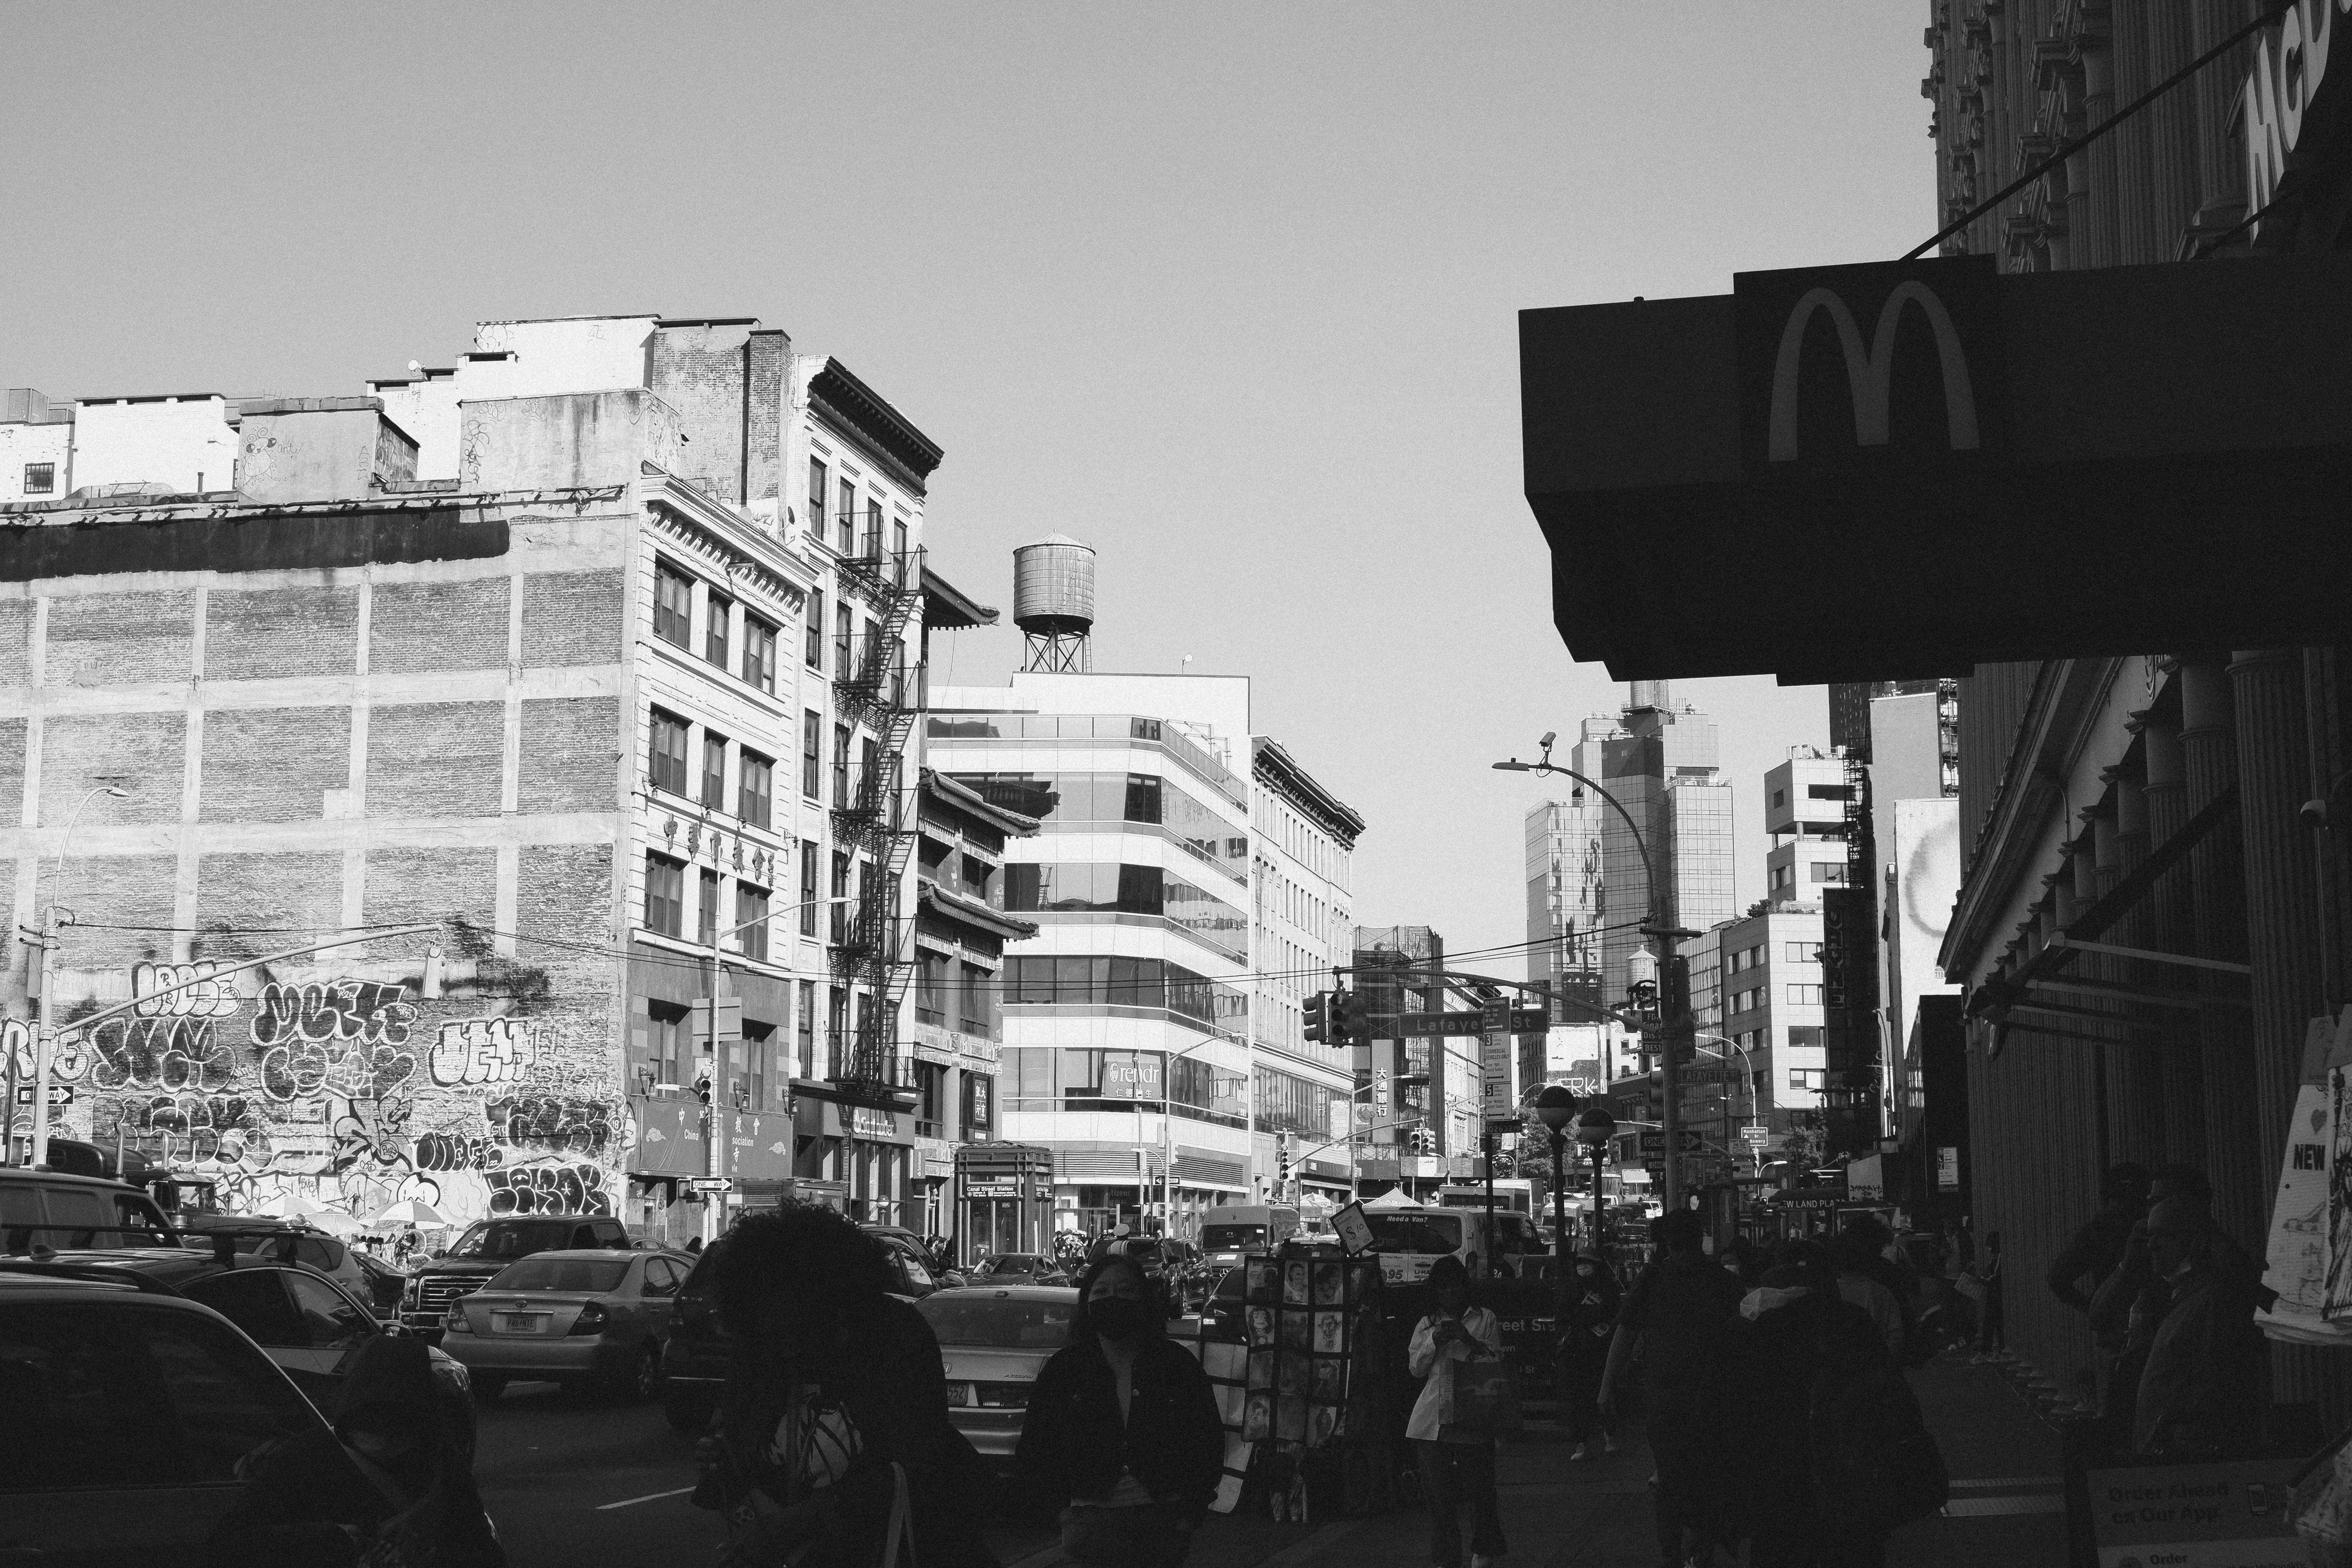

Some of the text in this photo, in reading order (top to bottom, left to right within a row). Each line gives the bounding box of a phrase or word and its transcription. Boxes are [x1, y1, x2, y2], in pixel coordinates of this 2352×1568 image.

[1417, 1016, 1530, 1033] Lafaye St
[1486, 1034, 1490, 1045] 3
[1681, 1071, 1729, 1082] LAFAYETTE
[1115, 1087, 1152, 1098] 仁德生
[1376, 1067, 1388, 1117] 大通銀行
[1487, 1085, 1491, 1096] 5
[861, 1116, 894, 1137] Santander
[684, 1129, 699, 1140] China
[732, 1136, 754, 1147] sociation
[2293, 1144, 2326, 1171] NEW
[2109, 1481, 2230, 1503] Order Ahead
[2140, 1508, 2176, 1522] Our
[2181, 1504, 2219, 1523] App
[2150, 1553, 2188, 1565] Order
